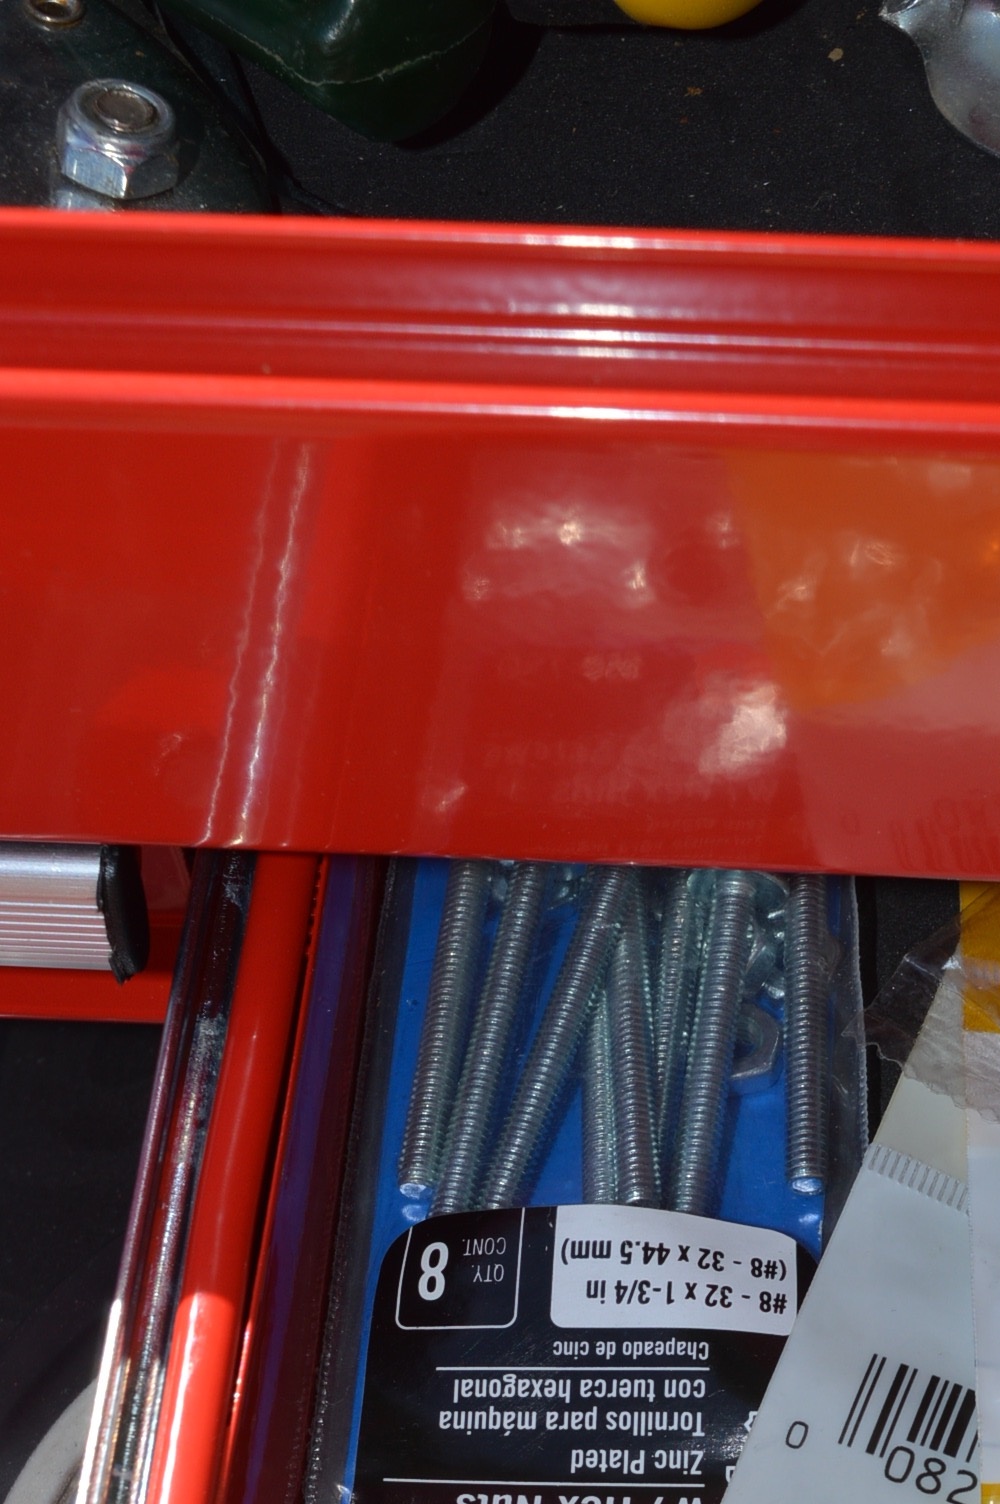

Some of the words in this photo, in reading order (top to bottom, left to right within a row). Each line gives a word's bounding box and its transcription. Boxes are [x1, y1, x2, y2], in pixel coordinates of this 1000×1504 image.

[462, 1237, 507, 1257] CONT.
[561, 1237, 612, 1267] mm)
[620, 1240, 671, 1266] 44.5
[677, 1244, 690, 1261] x
[697, 1247, 725, 1272] 32
[418, 1241, 450, 1302] 8
[471, 1263, 504, 1283] QTY.
[750, 1256, 787, 1282] (#8
[586, 1280, 607, 1304] in
[614, 1279, 675, 1305] 1-3/4
[684, 1282, 697, 1300] x
[704, 1284, 733, 1308] 32
[759, 1291, 788, 1315] #8
[553, 1341, 590, 1360] cinc
[596, 1341, 616, 1360] de
[622, 1338, 709, 1360] Chapeado
[453, 1374, 571, 1404] hexagonal
[580, 1379, 655, 1403] tuerca
[664, 1379, 706, 1401] con
[438, 1406, 537, 1437] máquina
[546, 1406, 598, 1432] para
[606, 1411, 706, 1437] Tornillos
[785, 1421, 809, 1449] 0
[571, 1449, 645, 1474] Plated
[654, 1449, 704, 1475] Zinc
